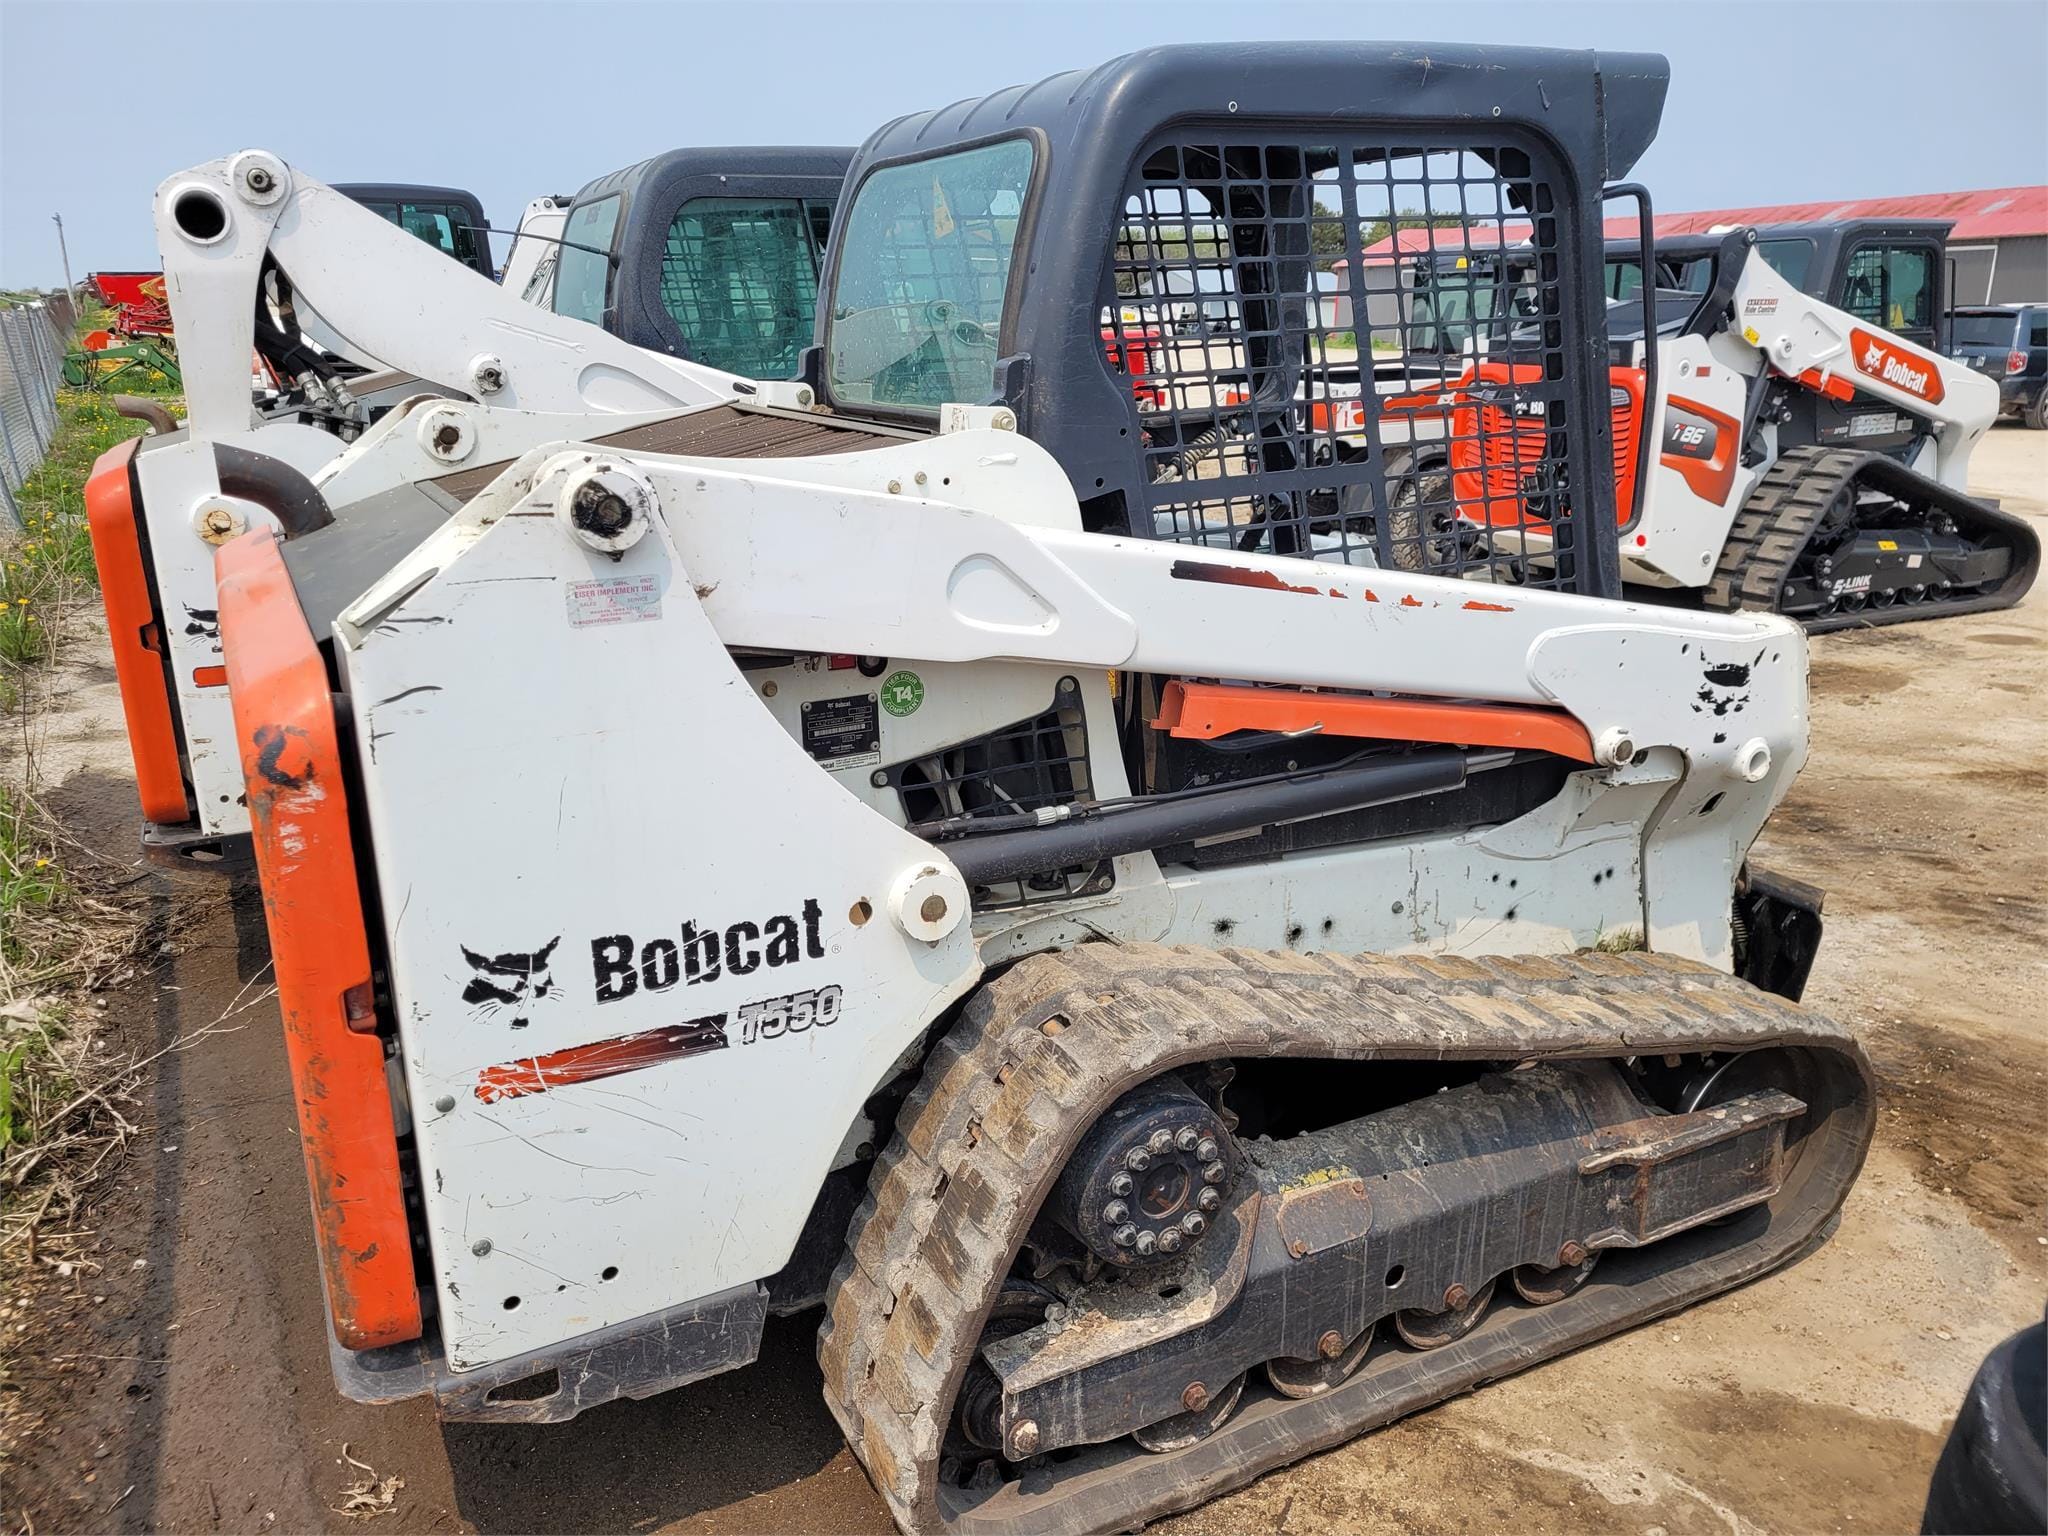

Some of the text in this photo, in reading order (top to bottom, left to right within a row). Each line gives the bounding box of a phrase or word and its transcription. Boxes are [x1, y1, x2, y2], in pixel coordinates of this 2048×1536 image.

[1882, 354, 1928, 394] Bobcat
[1671, 422, 1707, 445] T86
[574, 584, 657, 599] EISER IMPLEMENT INC.
[1831, 574, 1872, 595] 5-LINK
[887, 673, 918, 688] TIER FOUR
[892, 685, 913, 703] T4
[886, 699, 919, 714] COMPLIANT
[591, 898, 825, 1005] Bobcat
[738, 984, 843, 1045] T550
